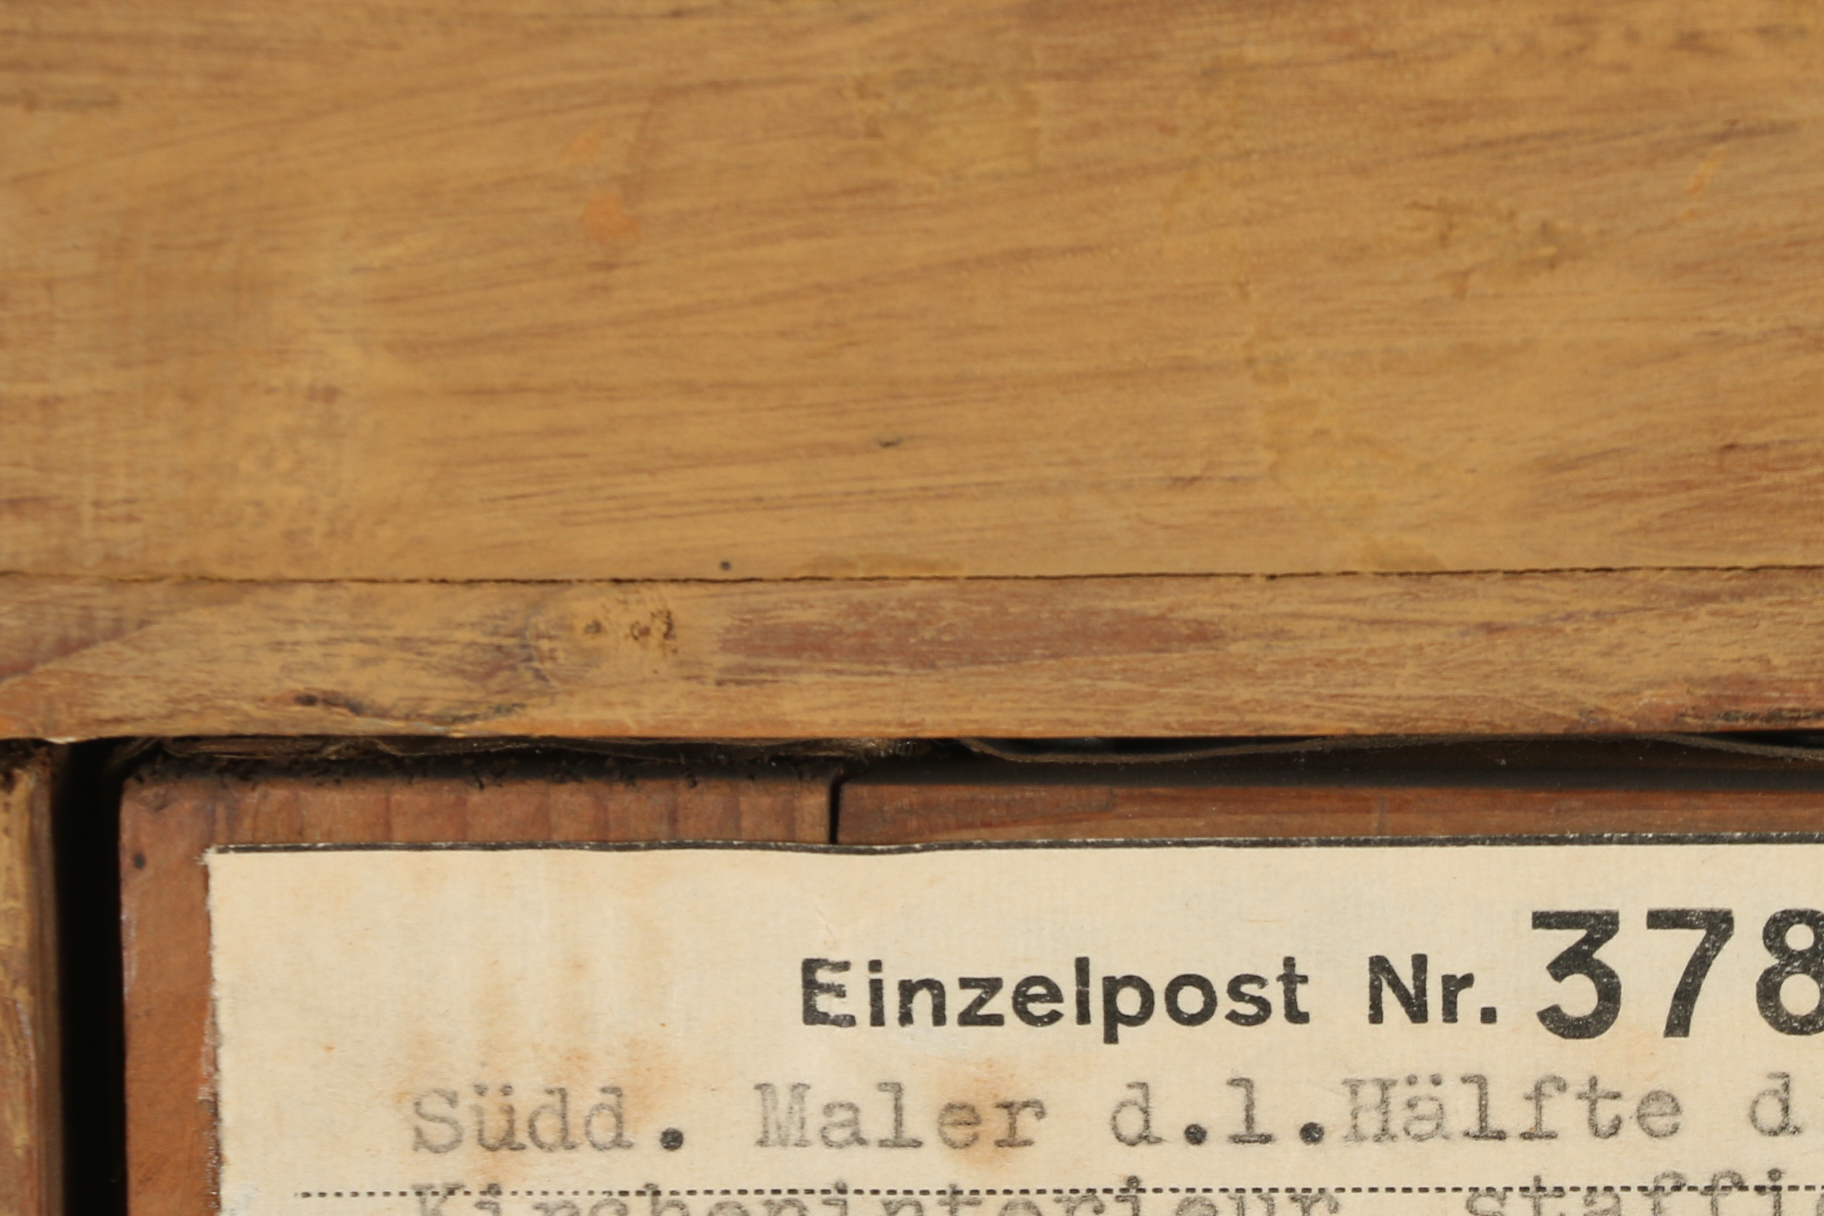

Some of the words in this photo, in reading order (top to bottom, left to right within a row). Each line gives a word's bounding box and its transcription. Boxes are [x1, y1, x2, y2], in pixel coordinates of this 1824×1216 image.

[799, 954, 1310, 1044] Einzelpost
[1367, 953, 1499, 1026] Nr.
[411, 1082, 684, 1153] Südd.
[753, 1079, 1047, 1149] Maler
